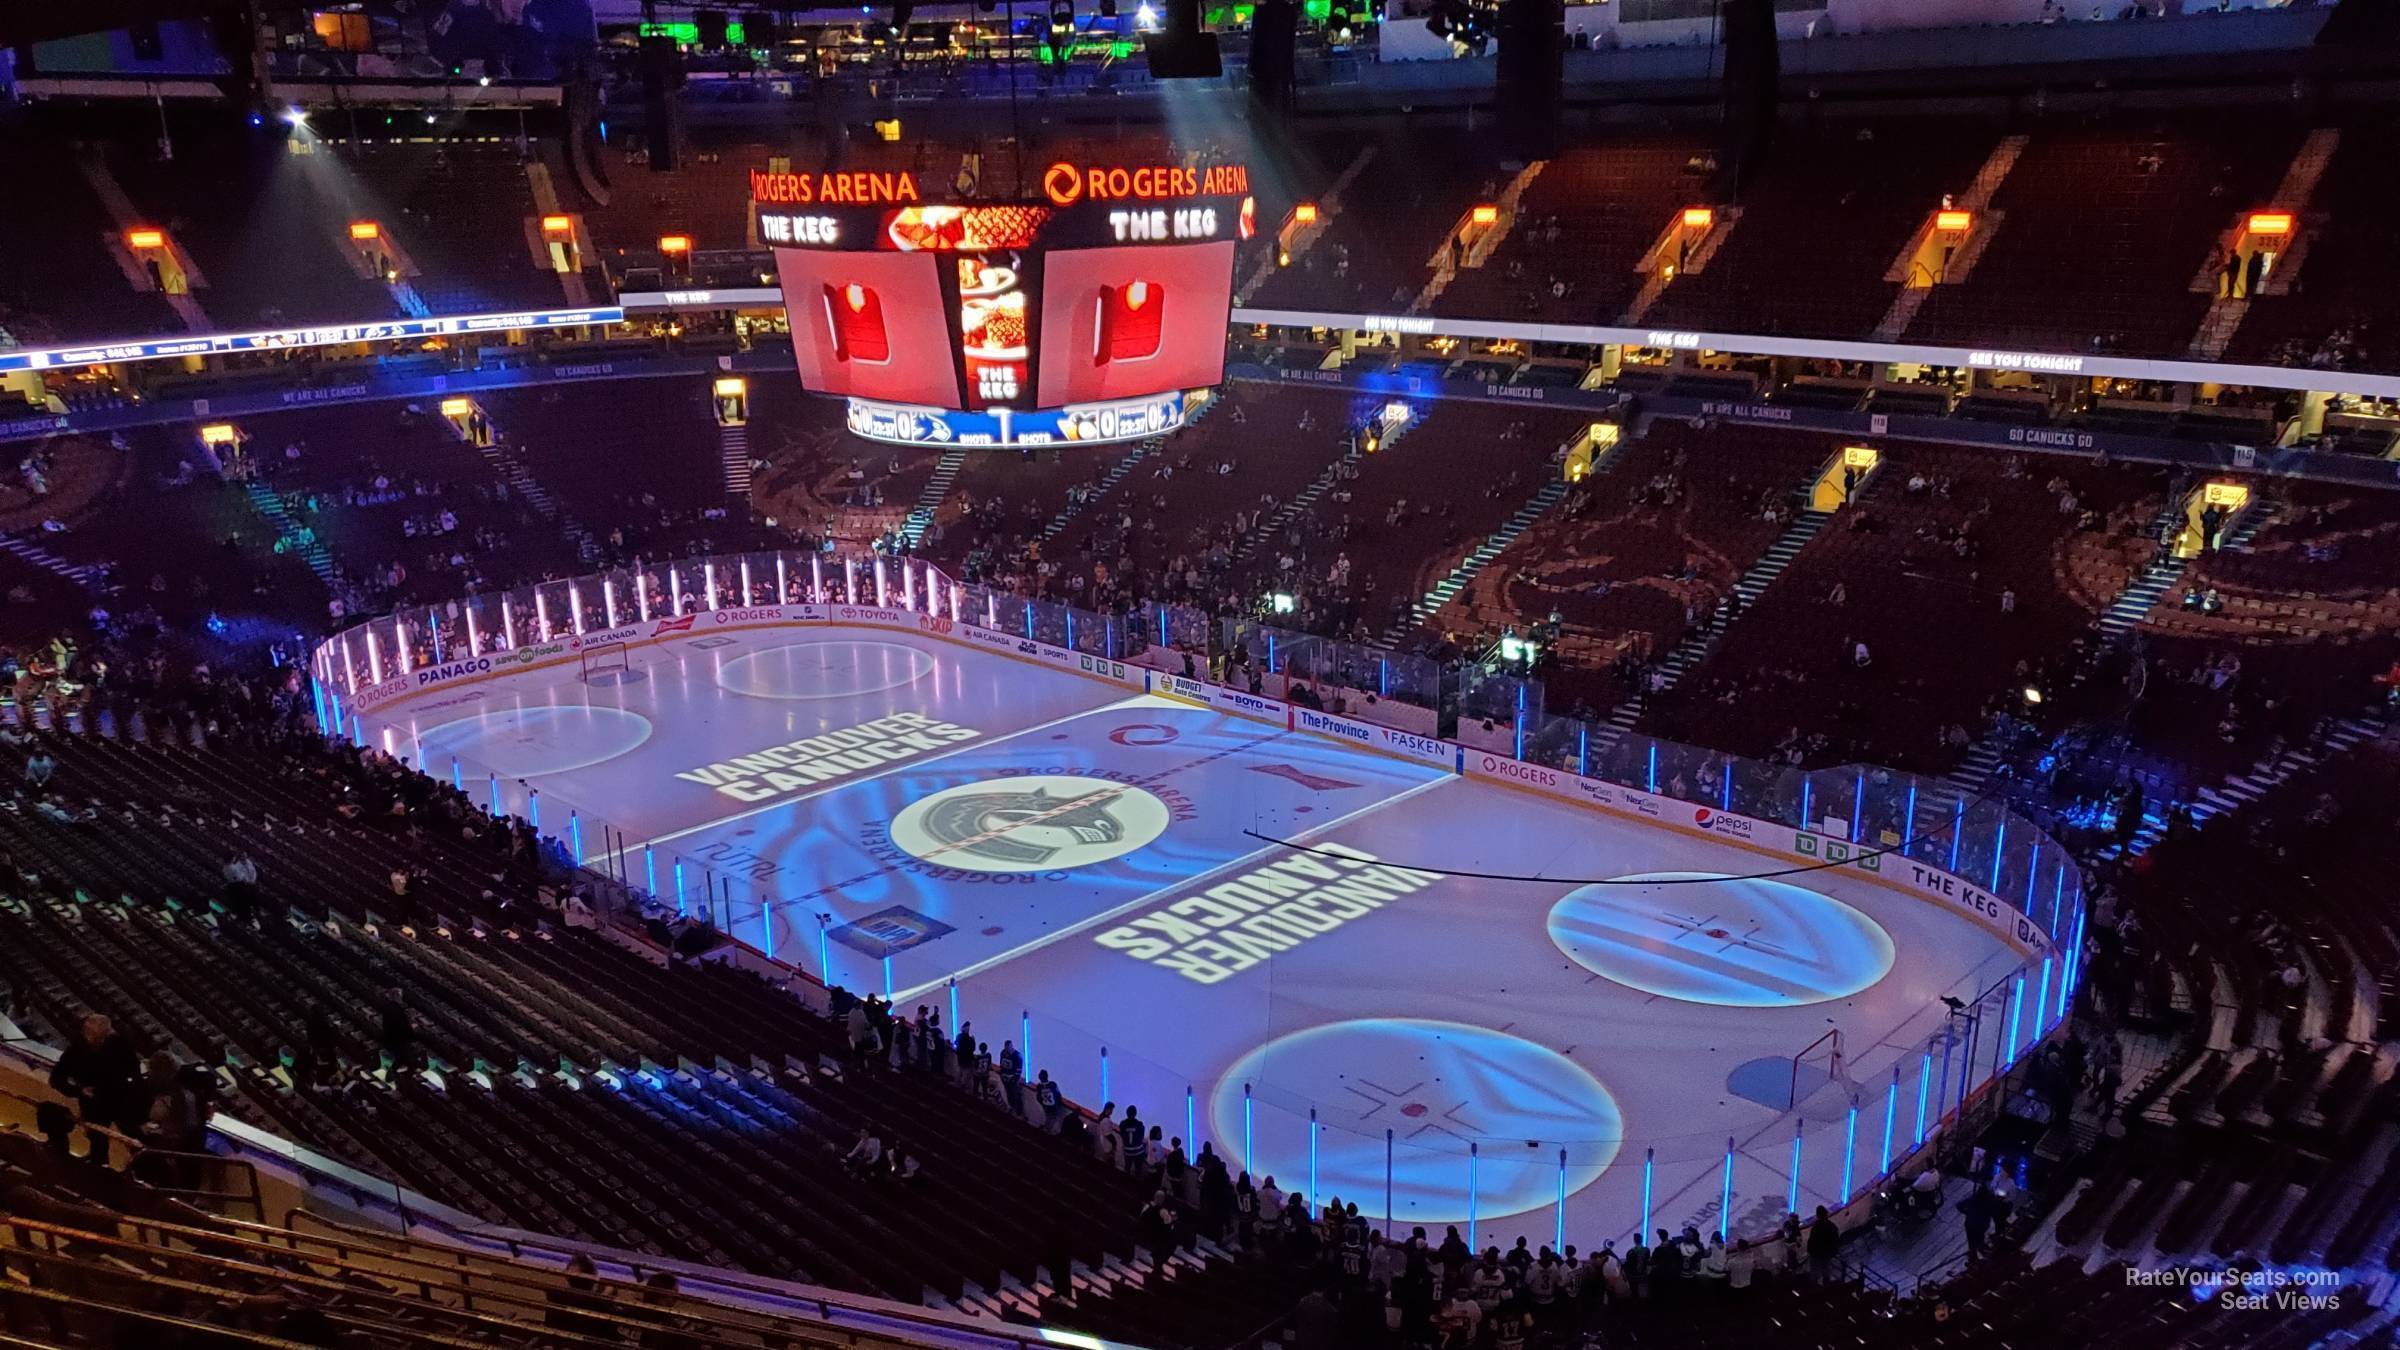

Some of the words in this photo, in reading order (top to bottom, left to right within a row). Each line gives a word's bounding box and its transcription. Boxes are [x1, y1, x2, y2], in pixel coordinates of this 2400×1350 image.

[756, 173, 812, 202] ROGERS
[820, 172, 919, 203] ARENA
[1088, 168, 1198, 198] ROGERS
[1202, 165, 1249, 195] ARENA
[761, 215, 792, 240] THE
[792, 216, 839, 243] KEG
[1109, 209, 1170, 241] THE
[1173, 207, 1218, 239] KEG
[1381, 317, 1397, 331] YOU
[1648, 332, 1673, 346] THE
[1674, 334, 1700, 347] KEG
[1969, 352, 1992, 366] SEE
[1993, 353, 2022, 368] YOU
[2023, 355, 2083, 372] TONIGHT
[977, 367, 1015, 381] THE
[979, 382, 1018, 399] KEG
[1702, 403, 1715, 413] WE
[1716, 404, 1731, 415] ARE
[1735, 405, 1749, 416] ALL
[1751, 406, 1791, 420] CANUCKS
[1101, 410, 1115, 437] 0
[1018, 432, 1052, 444] SHOTS
[2009, 428, 2024, 441] GO
[2026, 430, 2075, 446] CANUCKS
[2078, 434, 2093, 447] GO
[731, 608, 783, 622] ROGERS
[860, 608, 899, 622] TOYOTA
[930, 614, 953, 635] SKIP
[584, 638, 598, 647] AIR
[600, 629, 638, 643] CANADA
[983, 632, 1010, 647] CANADA
[534, 645, 564, 657] foods
[1043, 648, 1069, 661] SPORTS
[418, 658, 490, 686] PANAGO
[367, 678, 409, 704] ROGERS
[1175, 678, 1203, 692] BUDGET
[1235, 695, 1263, 709] BOYD
[1301, 711, 1320, 729] The
[1322, 717, 1370, 741] Province
[674, 711, 943, 788] VANCOUVER
[1391, 732, 1446, 756] FASKEN
[715, 722, 982, 802] CANUCKS
[1500, 761, 1557, 787] ROGERS
[1025, 766, 1140, 785] ROGERS
[1149, 783, 1199, 823] ARENA
[1580, 782, 1612, 798] NexGen
[1626, 794, 1659, 809] NexGen
[1716, 814, 1752, 832] pepsi
[1094, 842, 1379, 960] CANUCKS
[1911, 866, 1954, 897] THE
[1962, 887, 1998, 918] KEG
[1152, 864, 1446, 984] VANCOUVER
